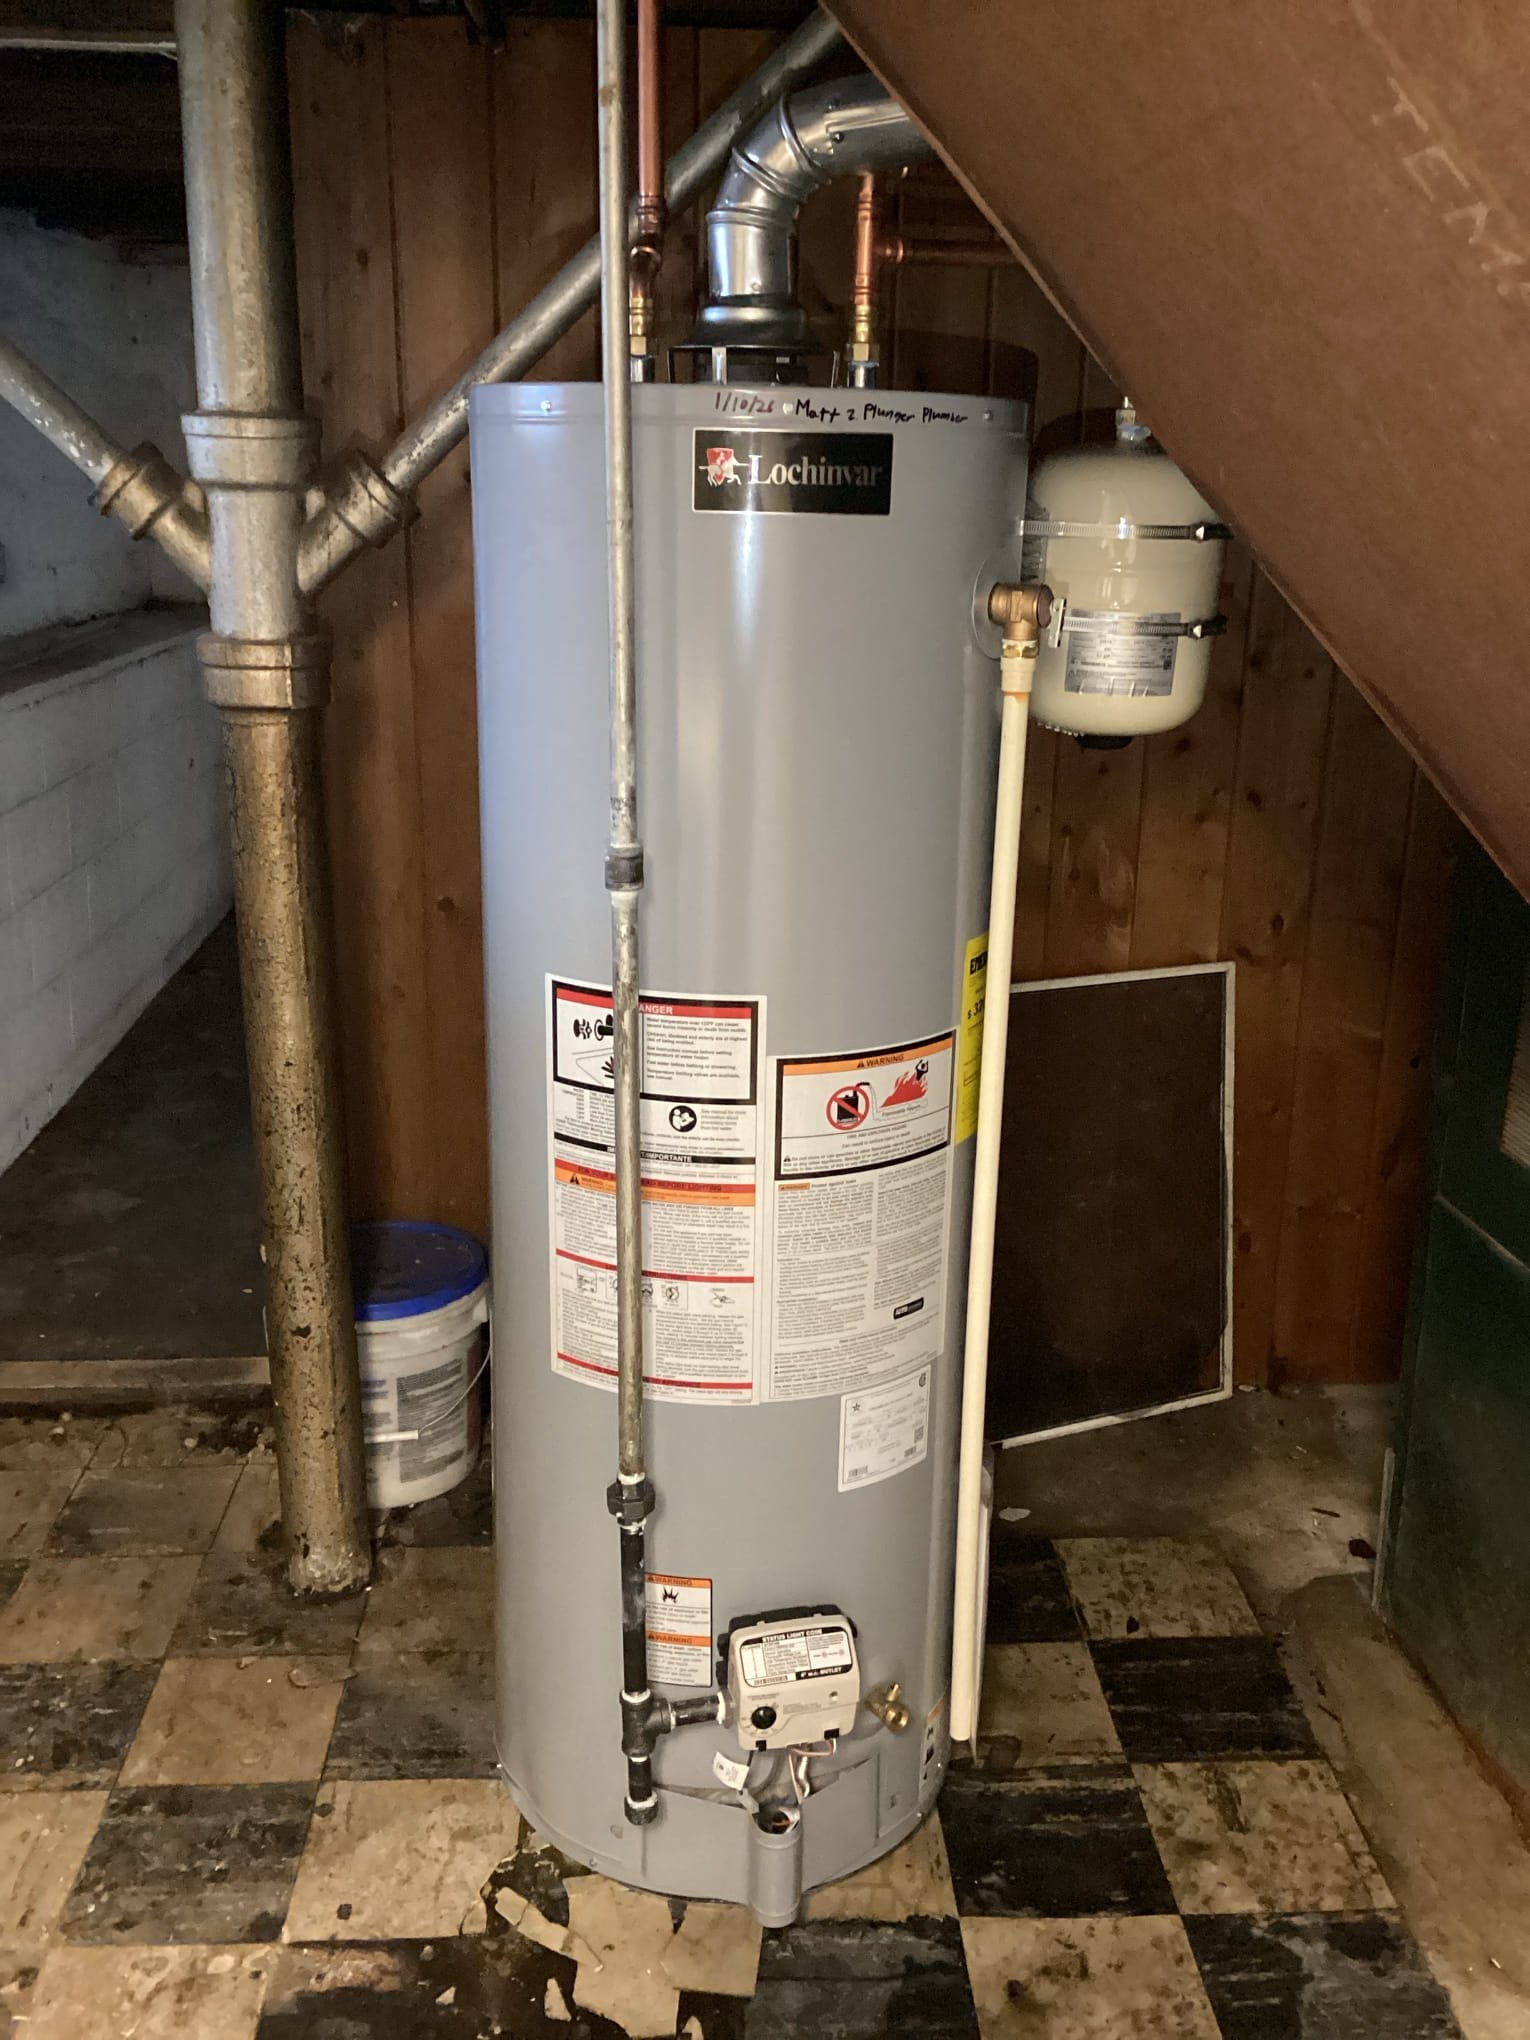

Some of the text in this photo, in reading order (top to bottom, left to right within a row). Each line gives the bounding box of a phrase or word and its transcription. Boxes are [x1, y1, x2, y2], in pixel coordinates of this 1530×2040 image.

[714, 391, 775, 413] 1/10/26
[748, 454, 883, 486] Lochinvar
[639, 1003, 673, 1015] ANGER
[867, 1054, 904, 1068] WARNING
[654, 1575, 693, 1587] WARNING
